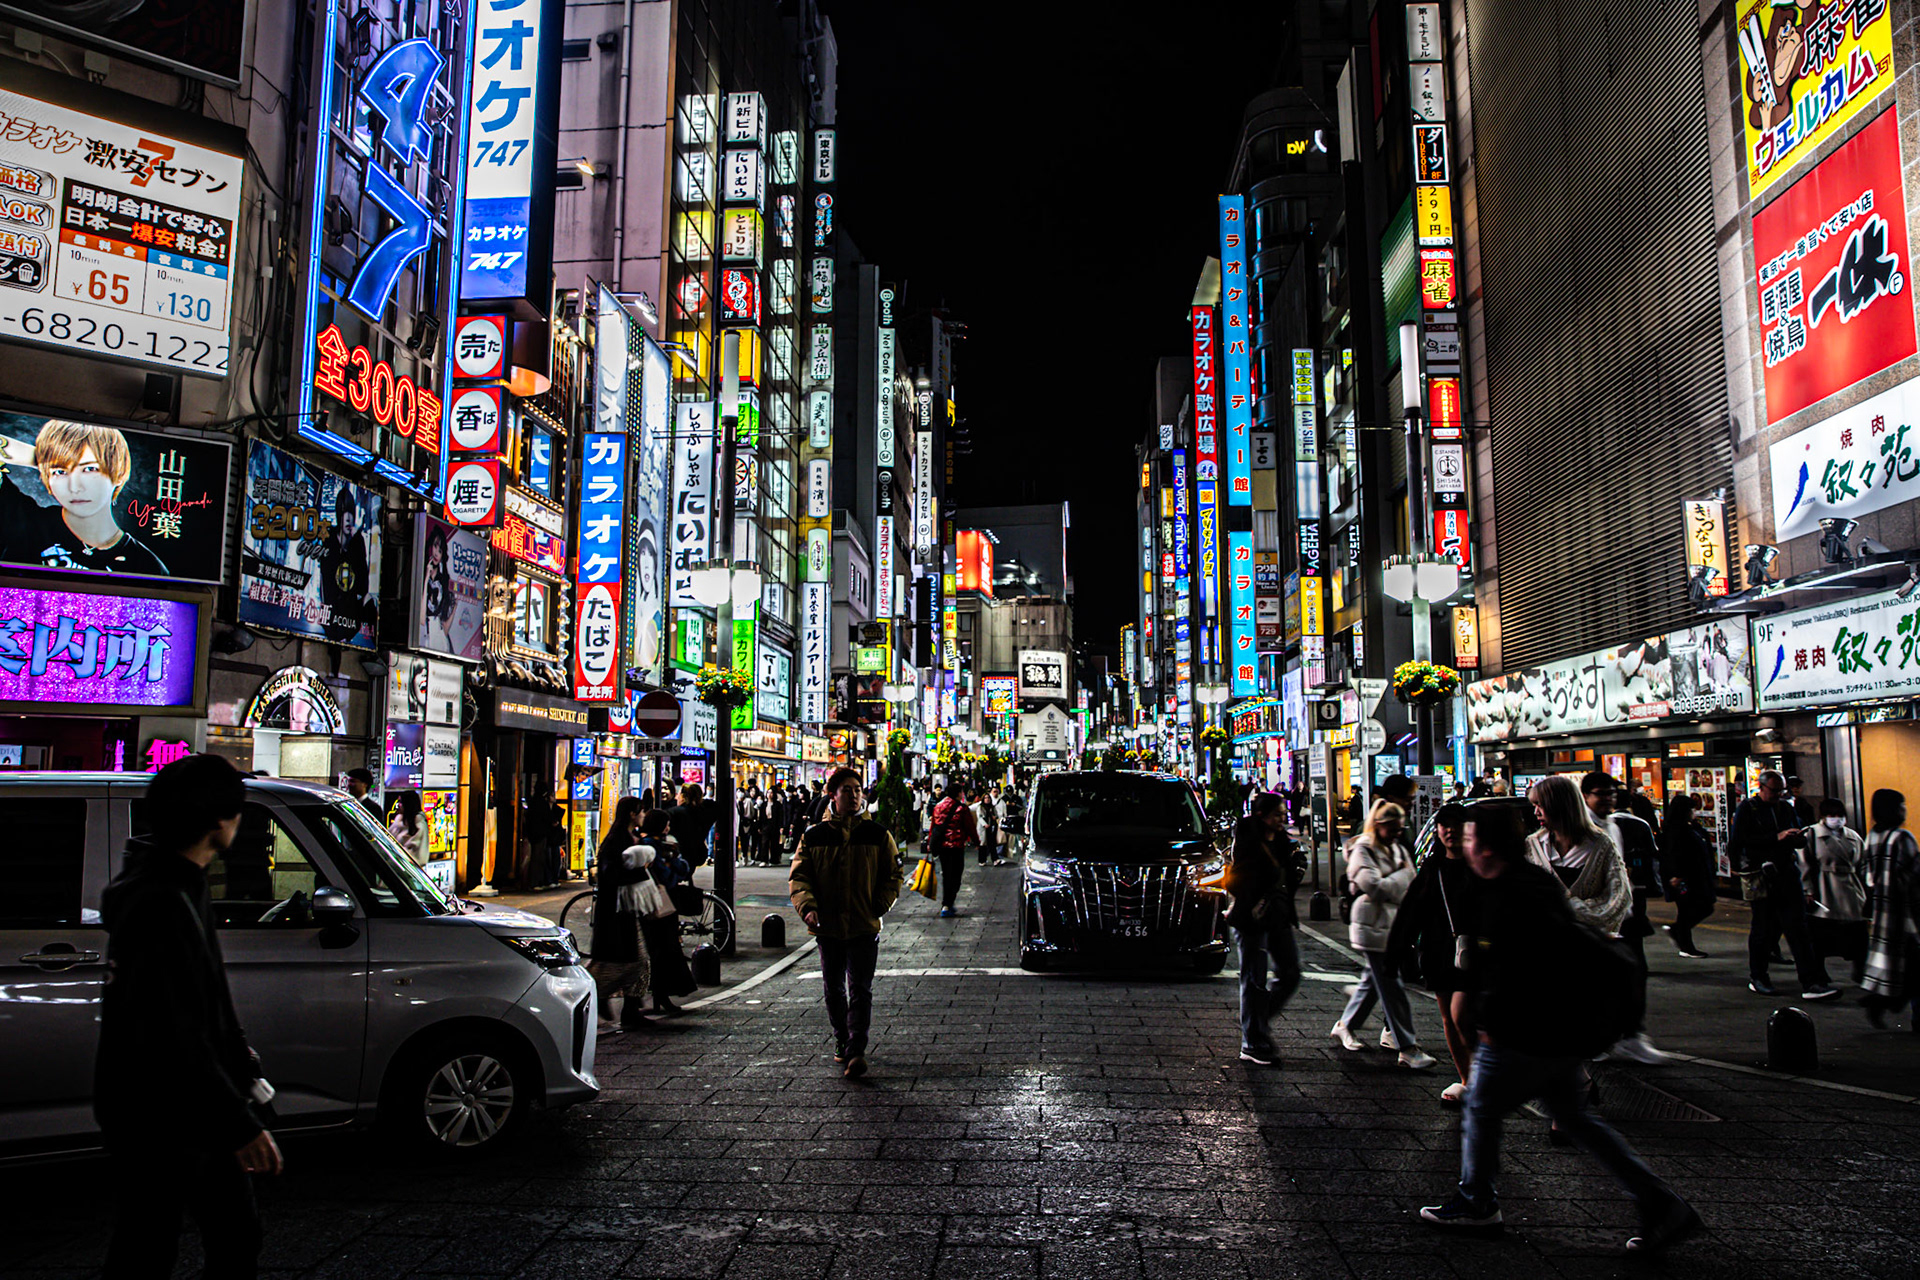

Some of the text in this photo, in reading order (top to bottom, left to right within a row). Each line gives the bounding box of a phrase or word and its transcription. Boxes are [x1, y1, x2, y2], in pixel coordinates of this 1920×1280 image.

[1416, 7, 1431, 58] 第1モナミビル
[735, 95, 751, 140] 川新ビル
[1753, 45, 1879, 176] ウェルカム
[473, 140, 530, 168] 747
[819, 139, 831, 178] 東京ビル
[1418, 128, 1428, 180] HIDEOUT
[1426, 127, 1444, 170] ダーツ
[153, 158, 229, 194] セブン
[734, 152, 748, 198] にいむら
[1431, 171, 1442, 180] 8F
[71, 184, 226, 239] 明朗会計で安心
[1429, 186, 1442, 236] 299円
[65, 206, 227, 260] 日本一爆安料金!
[467, 225, 527, 242] カラオケ
[734, 214, 746, 257] ととりこ
[1759, 190, 1874, 286] 東京で一番旨くて安い店
[467, 251, 524, 271] 747
[1423, 260, 1453, 302] 麻雀
[879, 288, 895, 325] Booth
[1762, 268, 1804, 327] 居酒屋
[1779, 309, 1791, 327] &
[882, 333, 891, 350] Net
[1225, 207, 1249, 492] カラオケ&パーティー館
[1765, 314, 1807, 368] 焼鳥
[1194, 311, 1215, 455] カラオケ歌広場
[882, 386, 891, 425] Capsule
[685, 407, 702, 487] しゃぶしゃぶ
[1840, 413, 1886, 450] 焼肉
[1819, 424, 1920, 505] 叙々苑
[452, 506, 488, 515] CIGARETTE
[582, 436, 621, 582] カラオケ
[1442, 493, 1457, 503] 3F
[880, 526, 889, 559] カラオケ
[1200, 508, 1214, 579] マツモトキヨ
[1308, 523, 1320, 570] AGEHA
[1255, 564, 1278, 573] つり具
[1236, 545, 1254, 681] カラオケ館
[1758, 622, 1775, 644] 9F
[1791, 617, 1813, 629] Japanese
[1849, 602, 1880, 615] Restaurant
[584, 597, 612, 674] たばこ
[806, 629, 821, 687] ルノアール
[1794, 645, 1826, 671] 焼肉
[254, 672, 342, 727] KANESHIMA BUILDING
[1806, 690, 1820, 699] Open
[1820, 689, 1828, 697] 24
[1828, 687, 1844, 696] Hours
[385, 746, 412, 766] alma
[637, 740, 678, 753] 自転車を除く
[576, 740, 593, 798] カラケ
